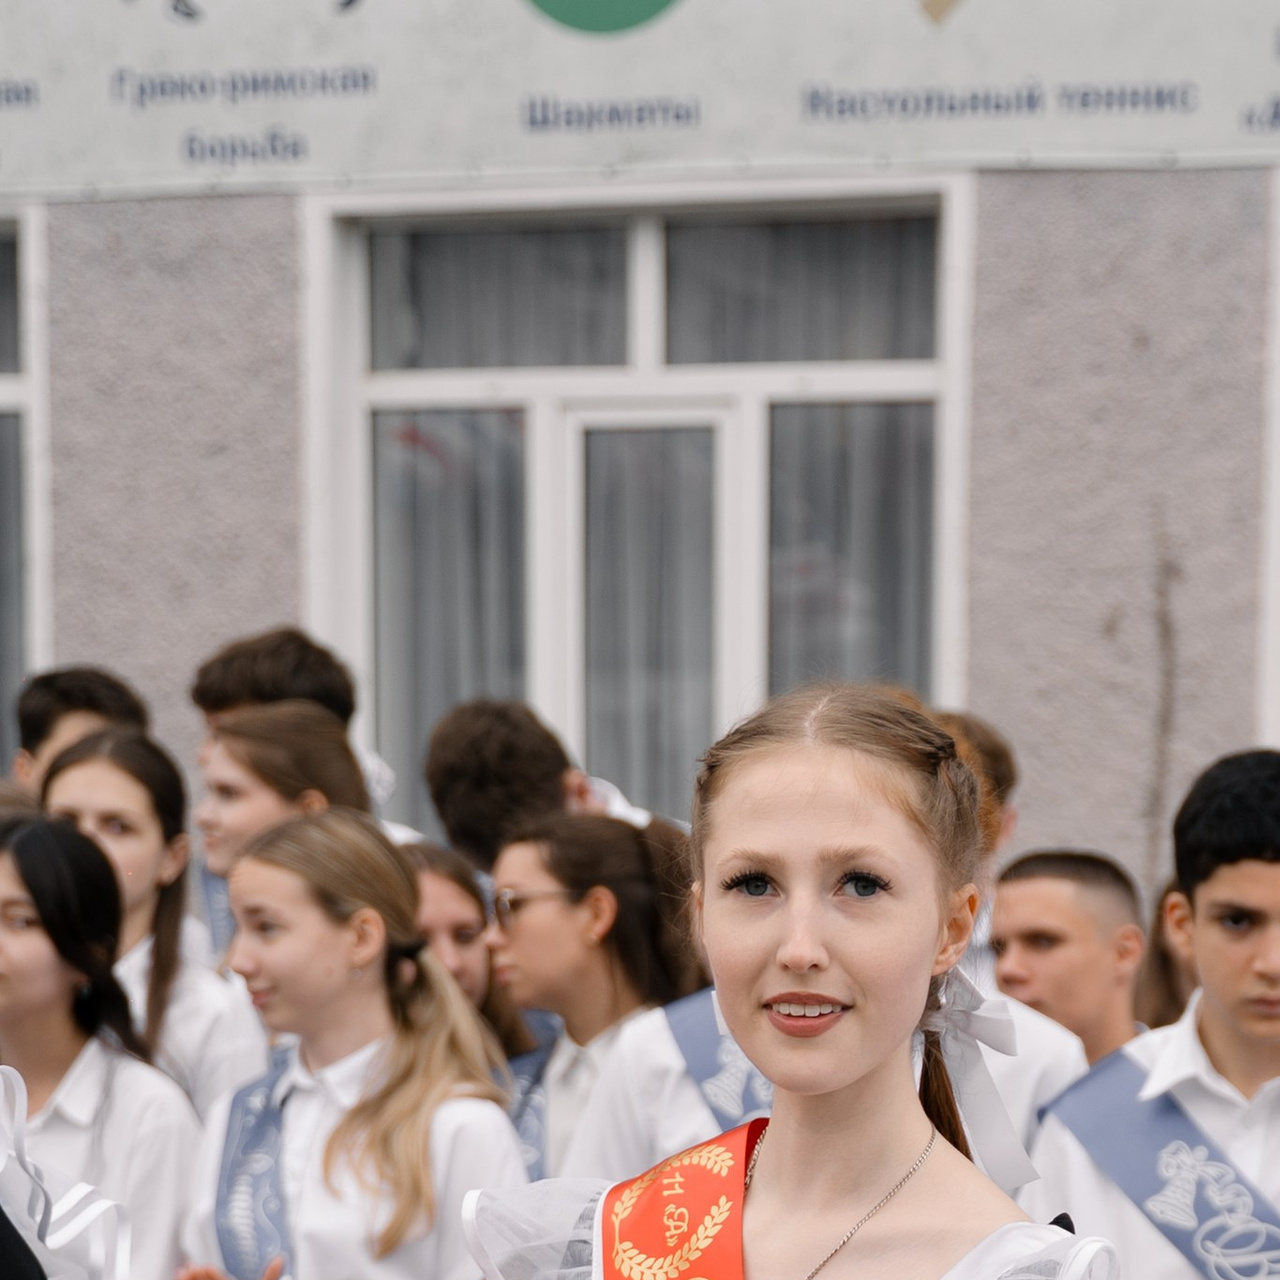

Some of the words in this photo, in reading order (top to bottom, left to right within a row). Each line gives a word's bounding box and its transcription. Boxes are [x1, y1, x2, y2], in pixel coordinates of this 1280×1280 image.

[111, 67, 375, 107] Греко-римская
[802, 76, 1044, 121] Настольный
[1057, 83, 1197, 116] теннис
[524, 95, 700, 133] Шахматы
[662, 1171, 685, 1197] 11
